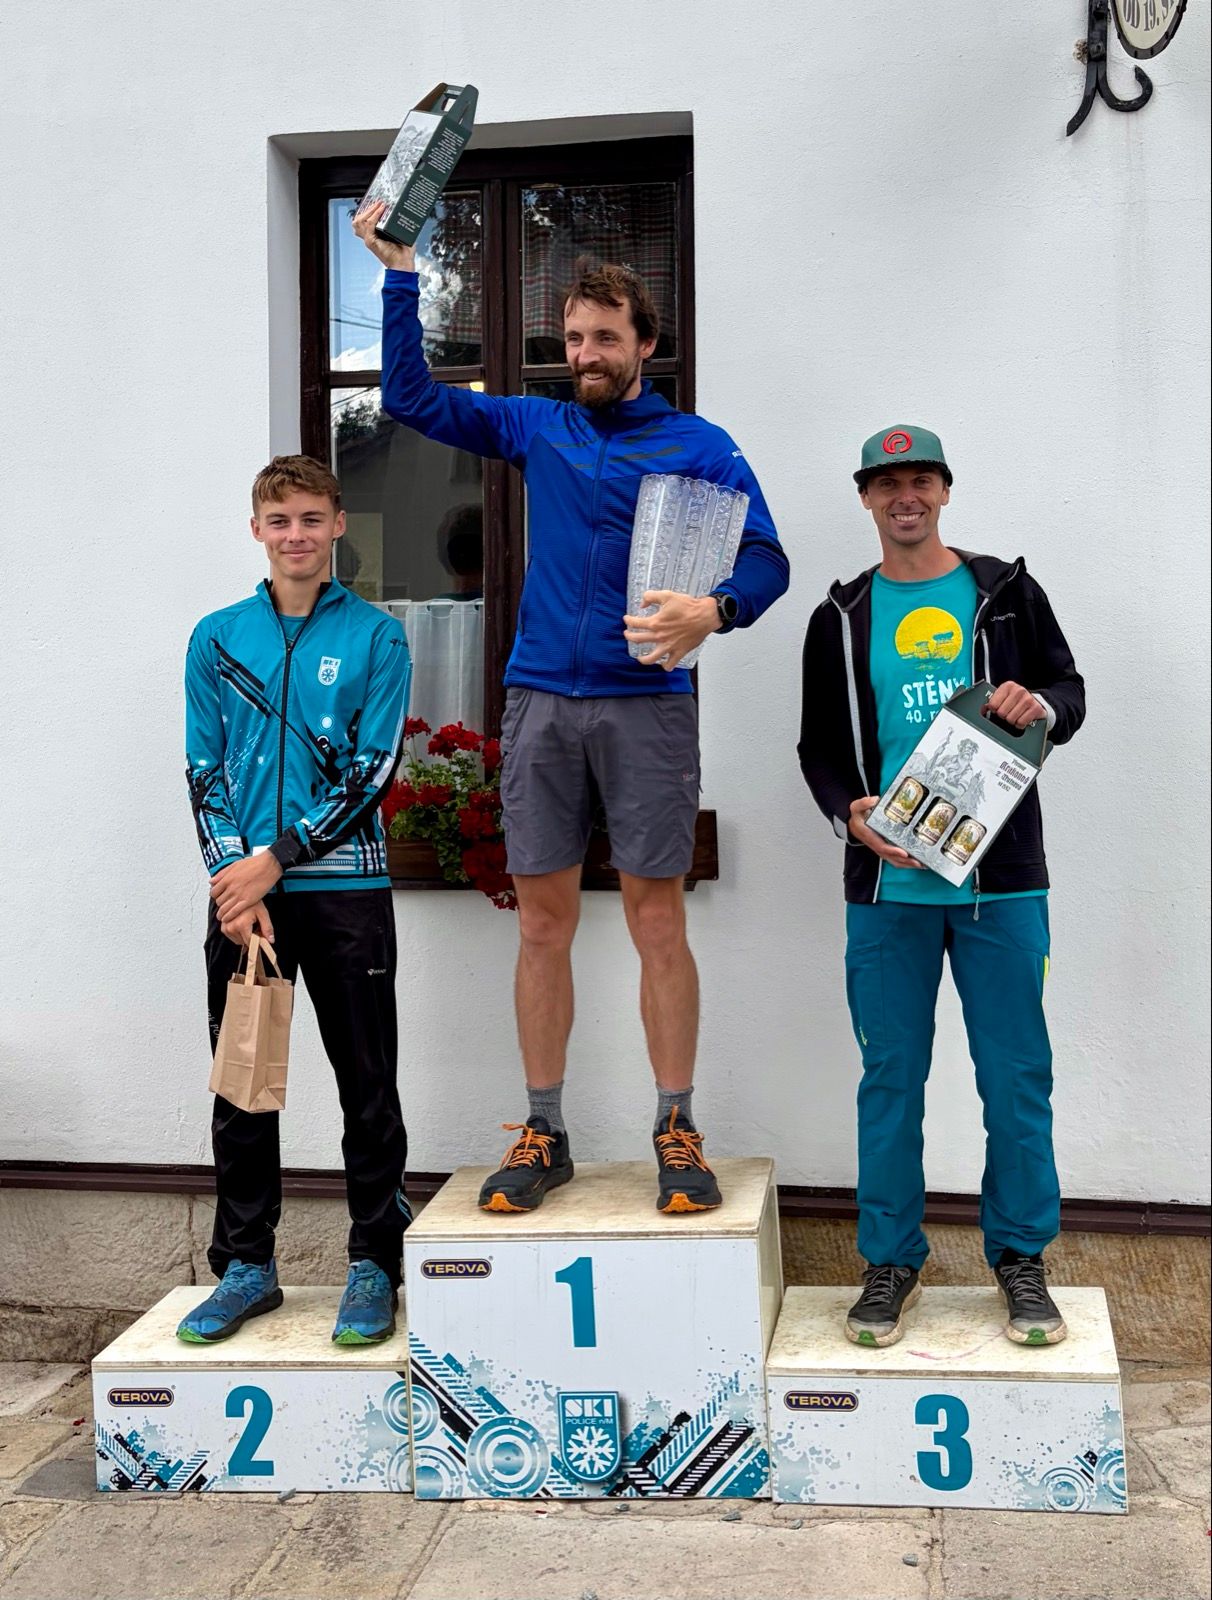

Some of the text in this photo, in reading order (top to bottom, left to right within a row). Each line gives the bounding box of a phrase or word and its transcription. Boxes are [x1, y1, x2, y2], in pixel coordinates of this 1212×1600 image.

[905, 709, 927, 724] 40.
[425, 1263, 488, 1274] TEROVA
[555, 1257, 597, 1348] 1
[111, 1392, 171, 1402] TEROVA
[788, 1395, 855, 1406] TEROVA
[564, 1398, 614, 1418] SKI
[565, 1417, 598, 1425] POLICE
[225, 1385, 275, 1477] 2
[914, 1393, 974, 1492] 3
